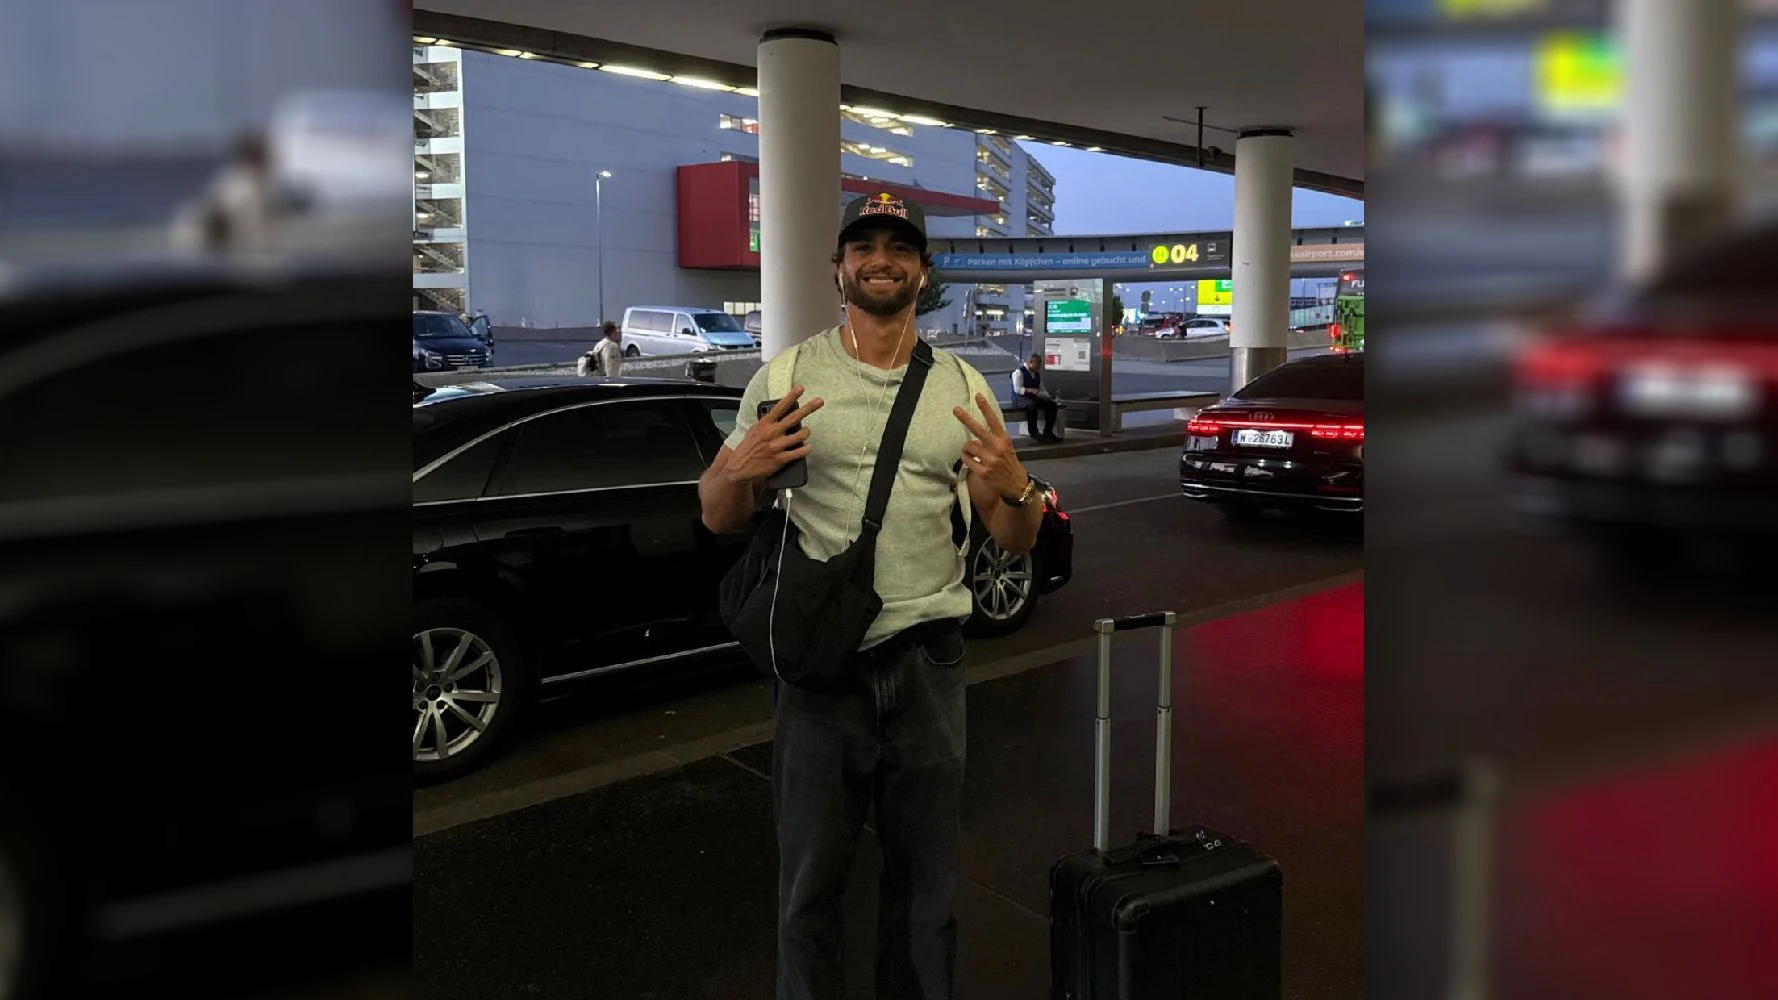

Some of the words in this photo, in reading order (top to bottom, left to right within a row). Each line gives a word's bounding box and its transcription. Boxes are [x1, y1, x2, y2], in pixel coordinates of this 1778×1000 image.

[859, 204, 884, 216] Red
[885, 205, 908, 219] Bull
[1171, 244, 1199, 263] 04
[968, 258, 996, 266] Parken
[998, 257, 1013, 266] mit
[1014, 256, 1053, 268] Köpfchen
[1063, 256, 1089, 265] online
[1091, 255, 1126, 267] gebucht
[1128, 255, 1146, 264] und
